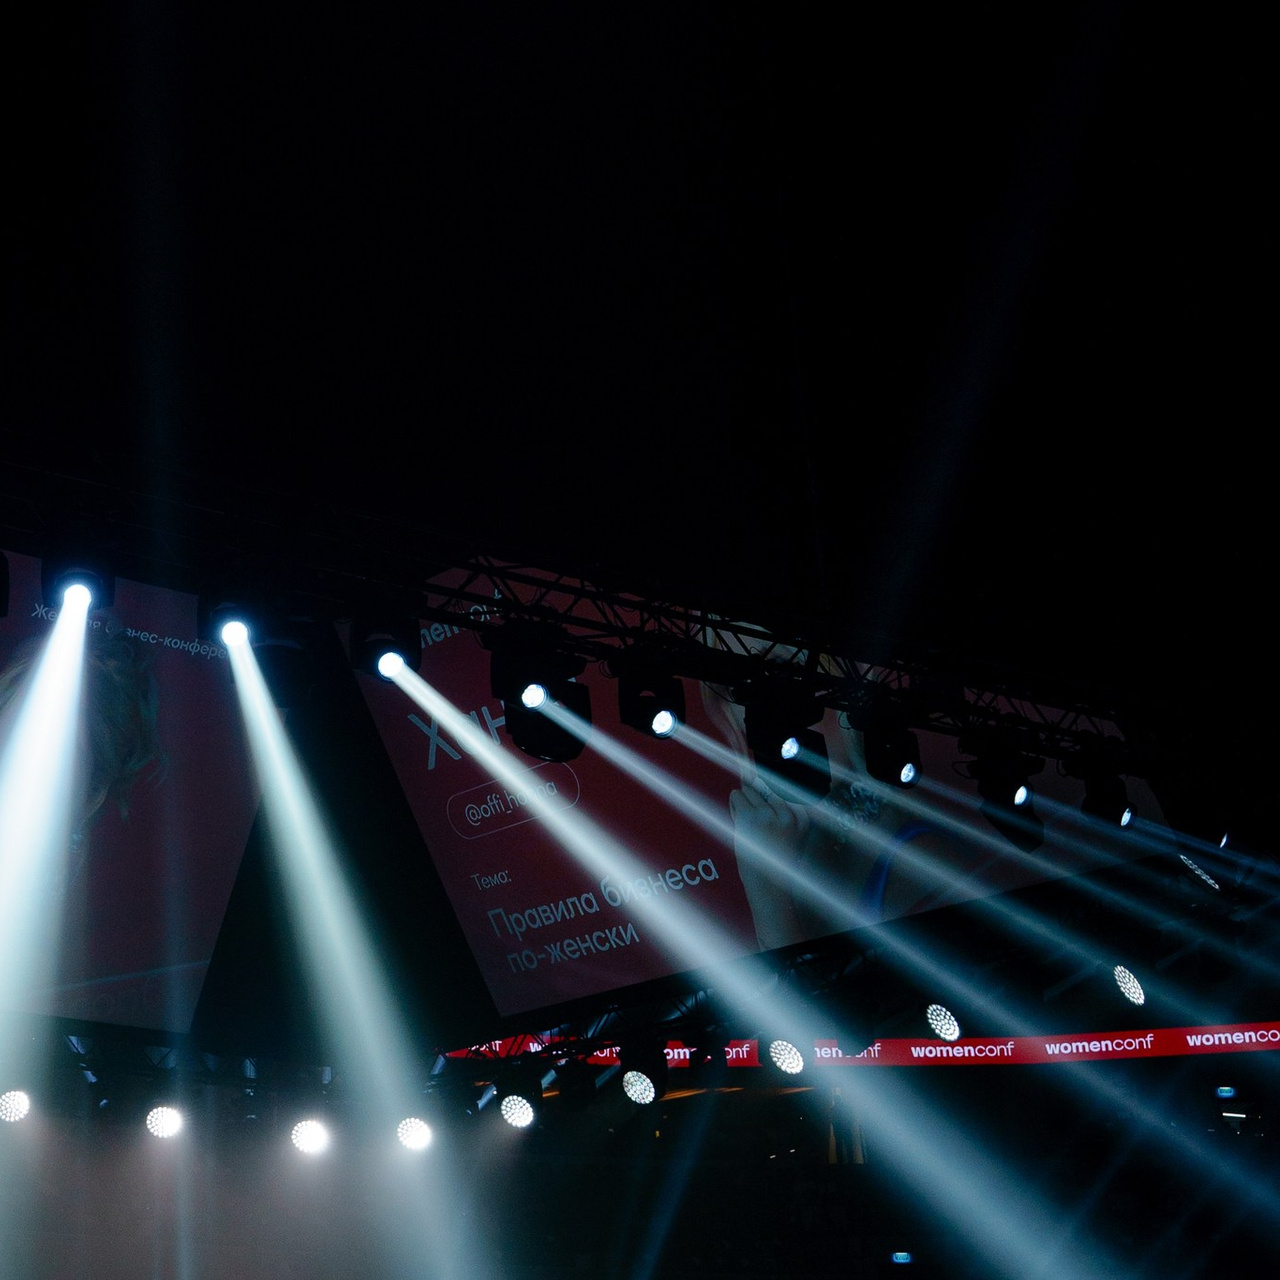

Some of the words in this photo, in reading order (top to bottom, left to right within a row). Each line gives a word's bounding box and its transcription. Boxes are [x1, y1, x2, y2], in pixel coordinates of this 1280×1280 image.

[471, 871, 512, 891] Тема:
[487, 891, 600, 942] Правила
[599, 858, 720, 908] бизнеса
[506, 922, 640, 973] по-женски
[911, 1041, 1015, 1059] womenconf
[1045, 1033, 1155, 1056] womenconf
[1186, 1029, 1280, 1047] womenco
